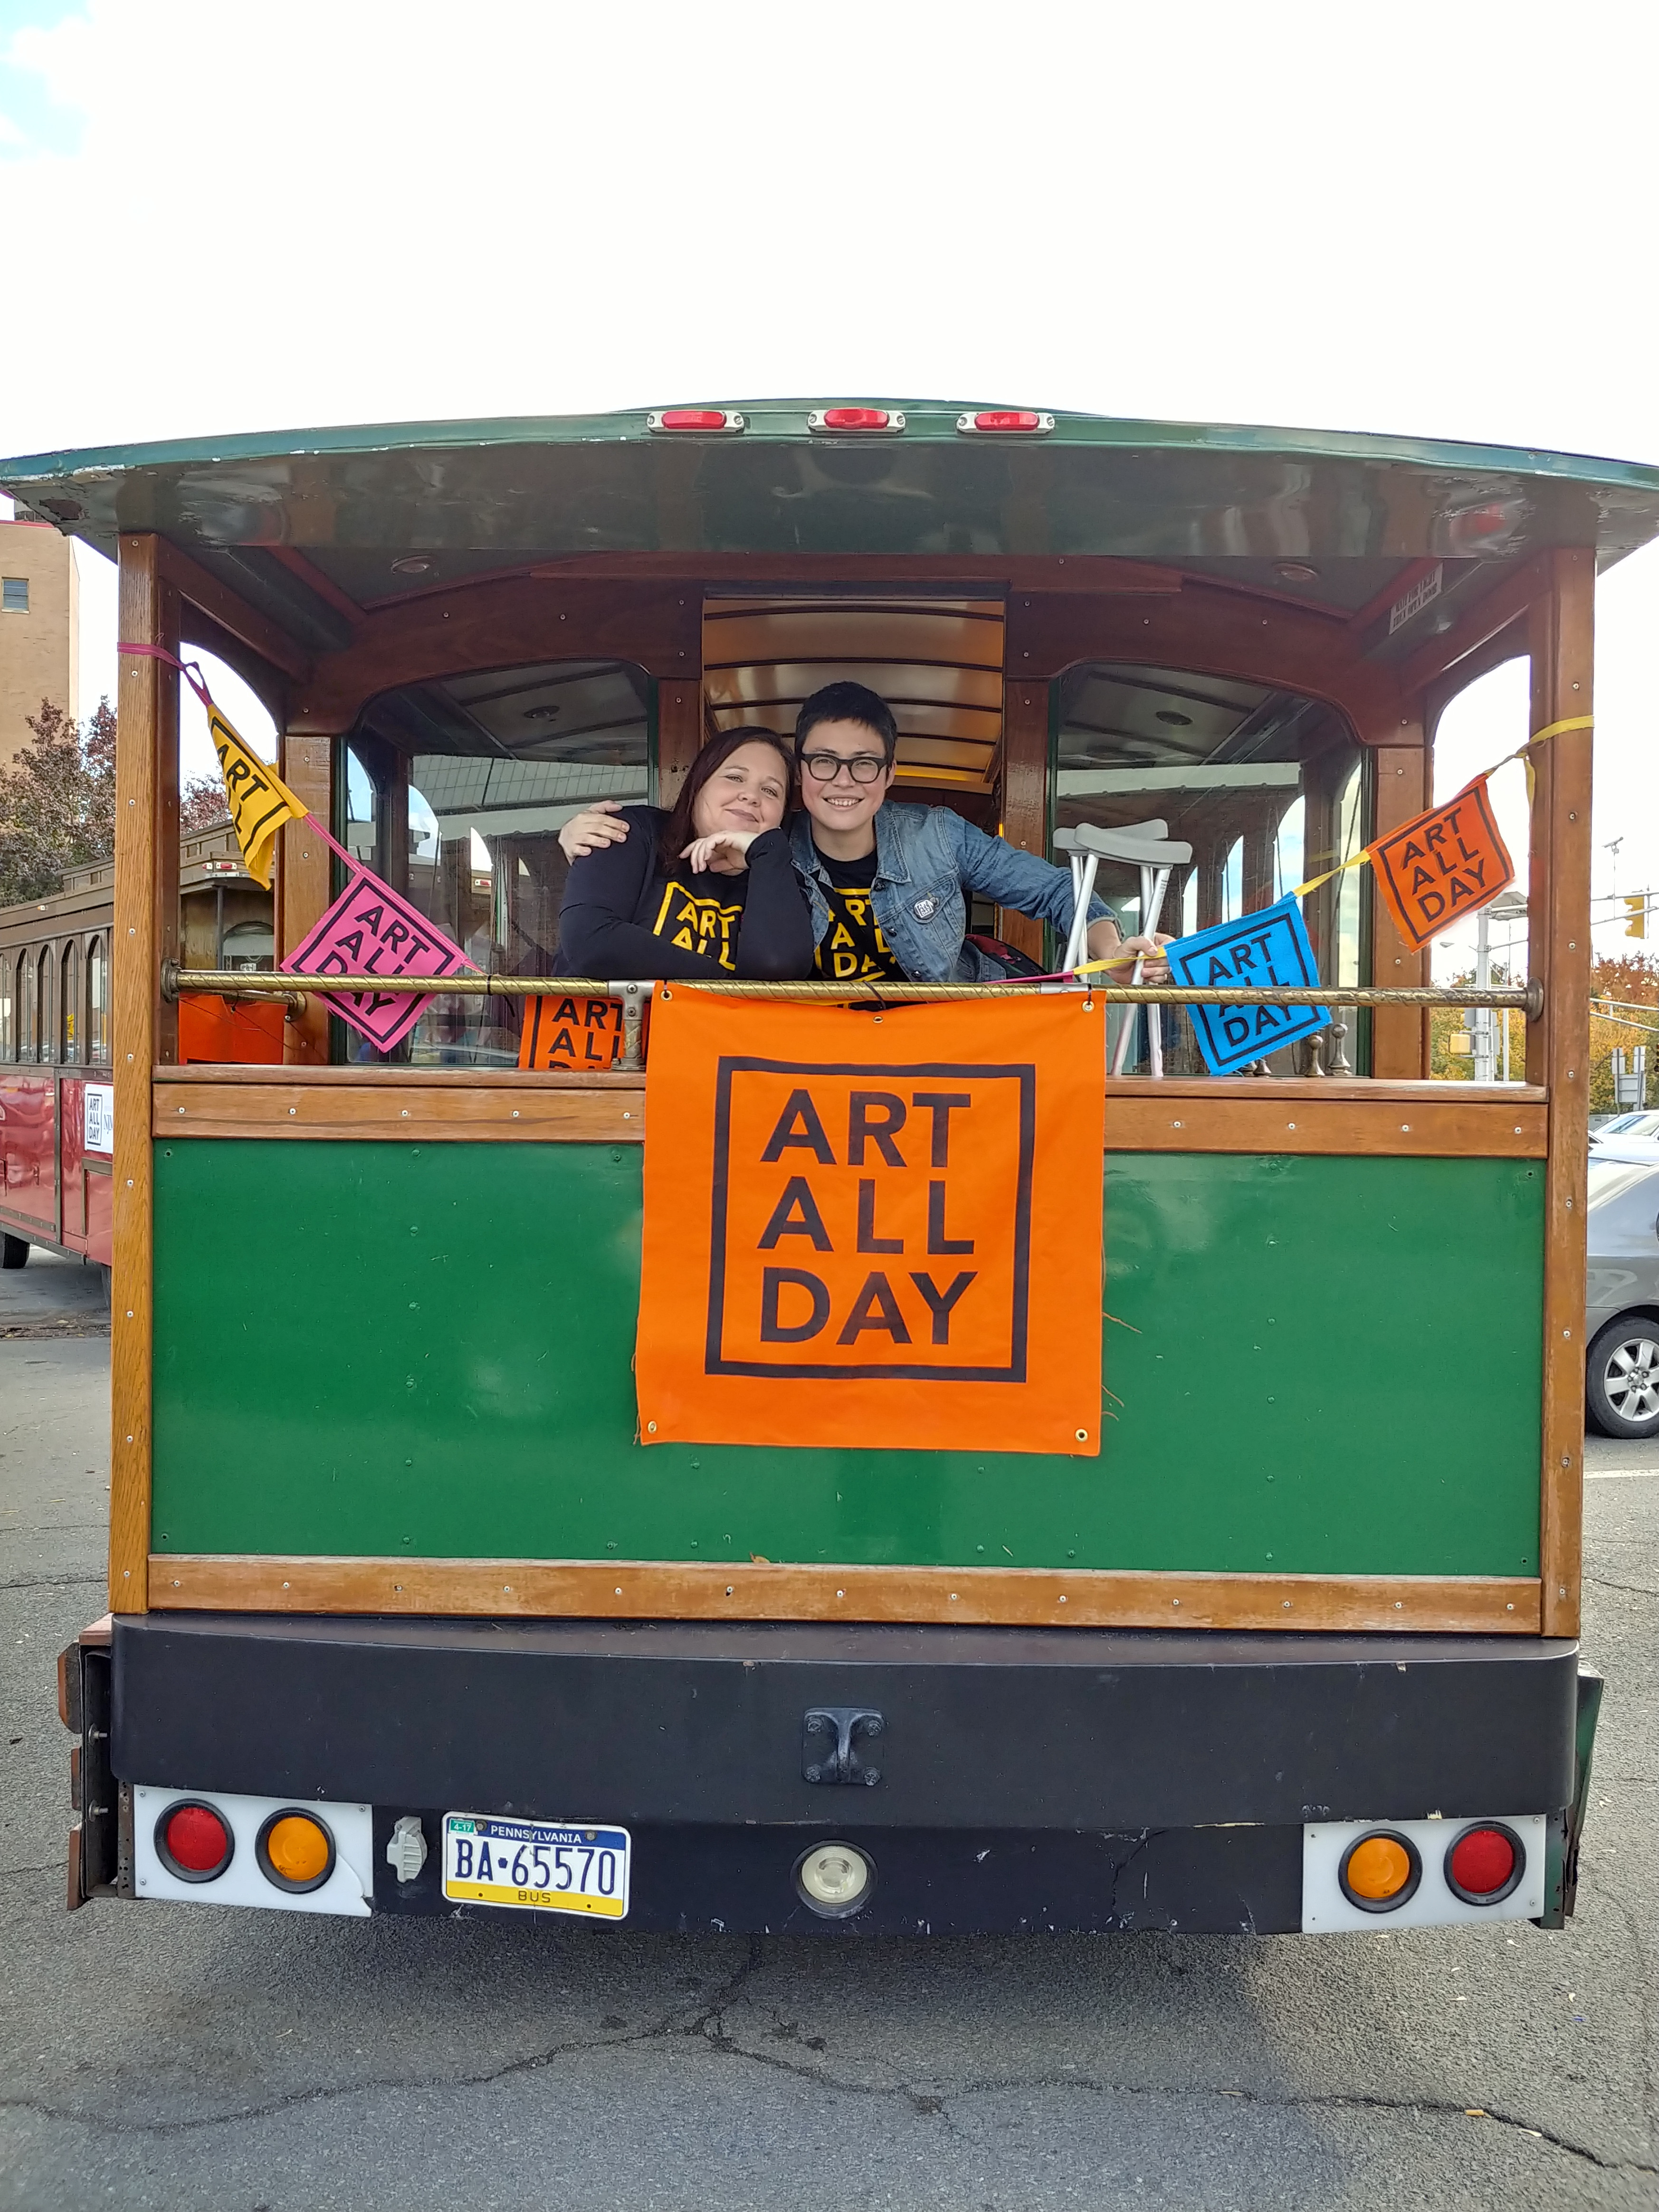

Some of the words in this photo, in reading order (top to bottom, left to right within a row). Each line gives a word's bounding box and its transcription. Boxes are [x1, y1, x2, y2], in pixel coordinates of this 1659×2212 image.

[1402, 806, 1461, 870] ART
[1412, 837, 1479, 896] ALL
[1417, 858, 1487, 923] DAY
[353, 905, 431, 964] ART
[676, 901, 735, 938] ART
[1209, 932, 1272, 986] ART
[552, 998, 623, 1032] ART
[89, 1098, 100, 1111] ART
[89, 1112, 100, 1125] ALL
[89, 1126, 100, 1140] DAY
[760, 1088, 971, 1168] ART
[756, 1175, 975, 1255] ALL
[760, 1266, 978, 1345] DAY
[454, 1823, 472, 1831] 4-17
[491, 1824, 582, 1843] PENNSYLVANIA
[518, 1890, 551, 1903] BUS
